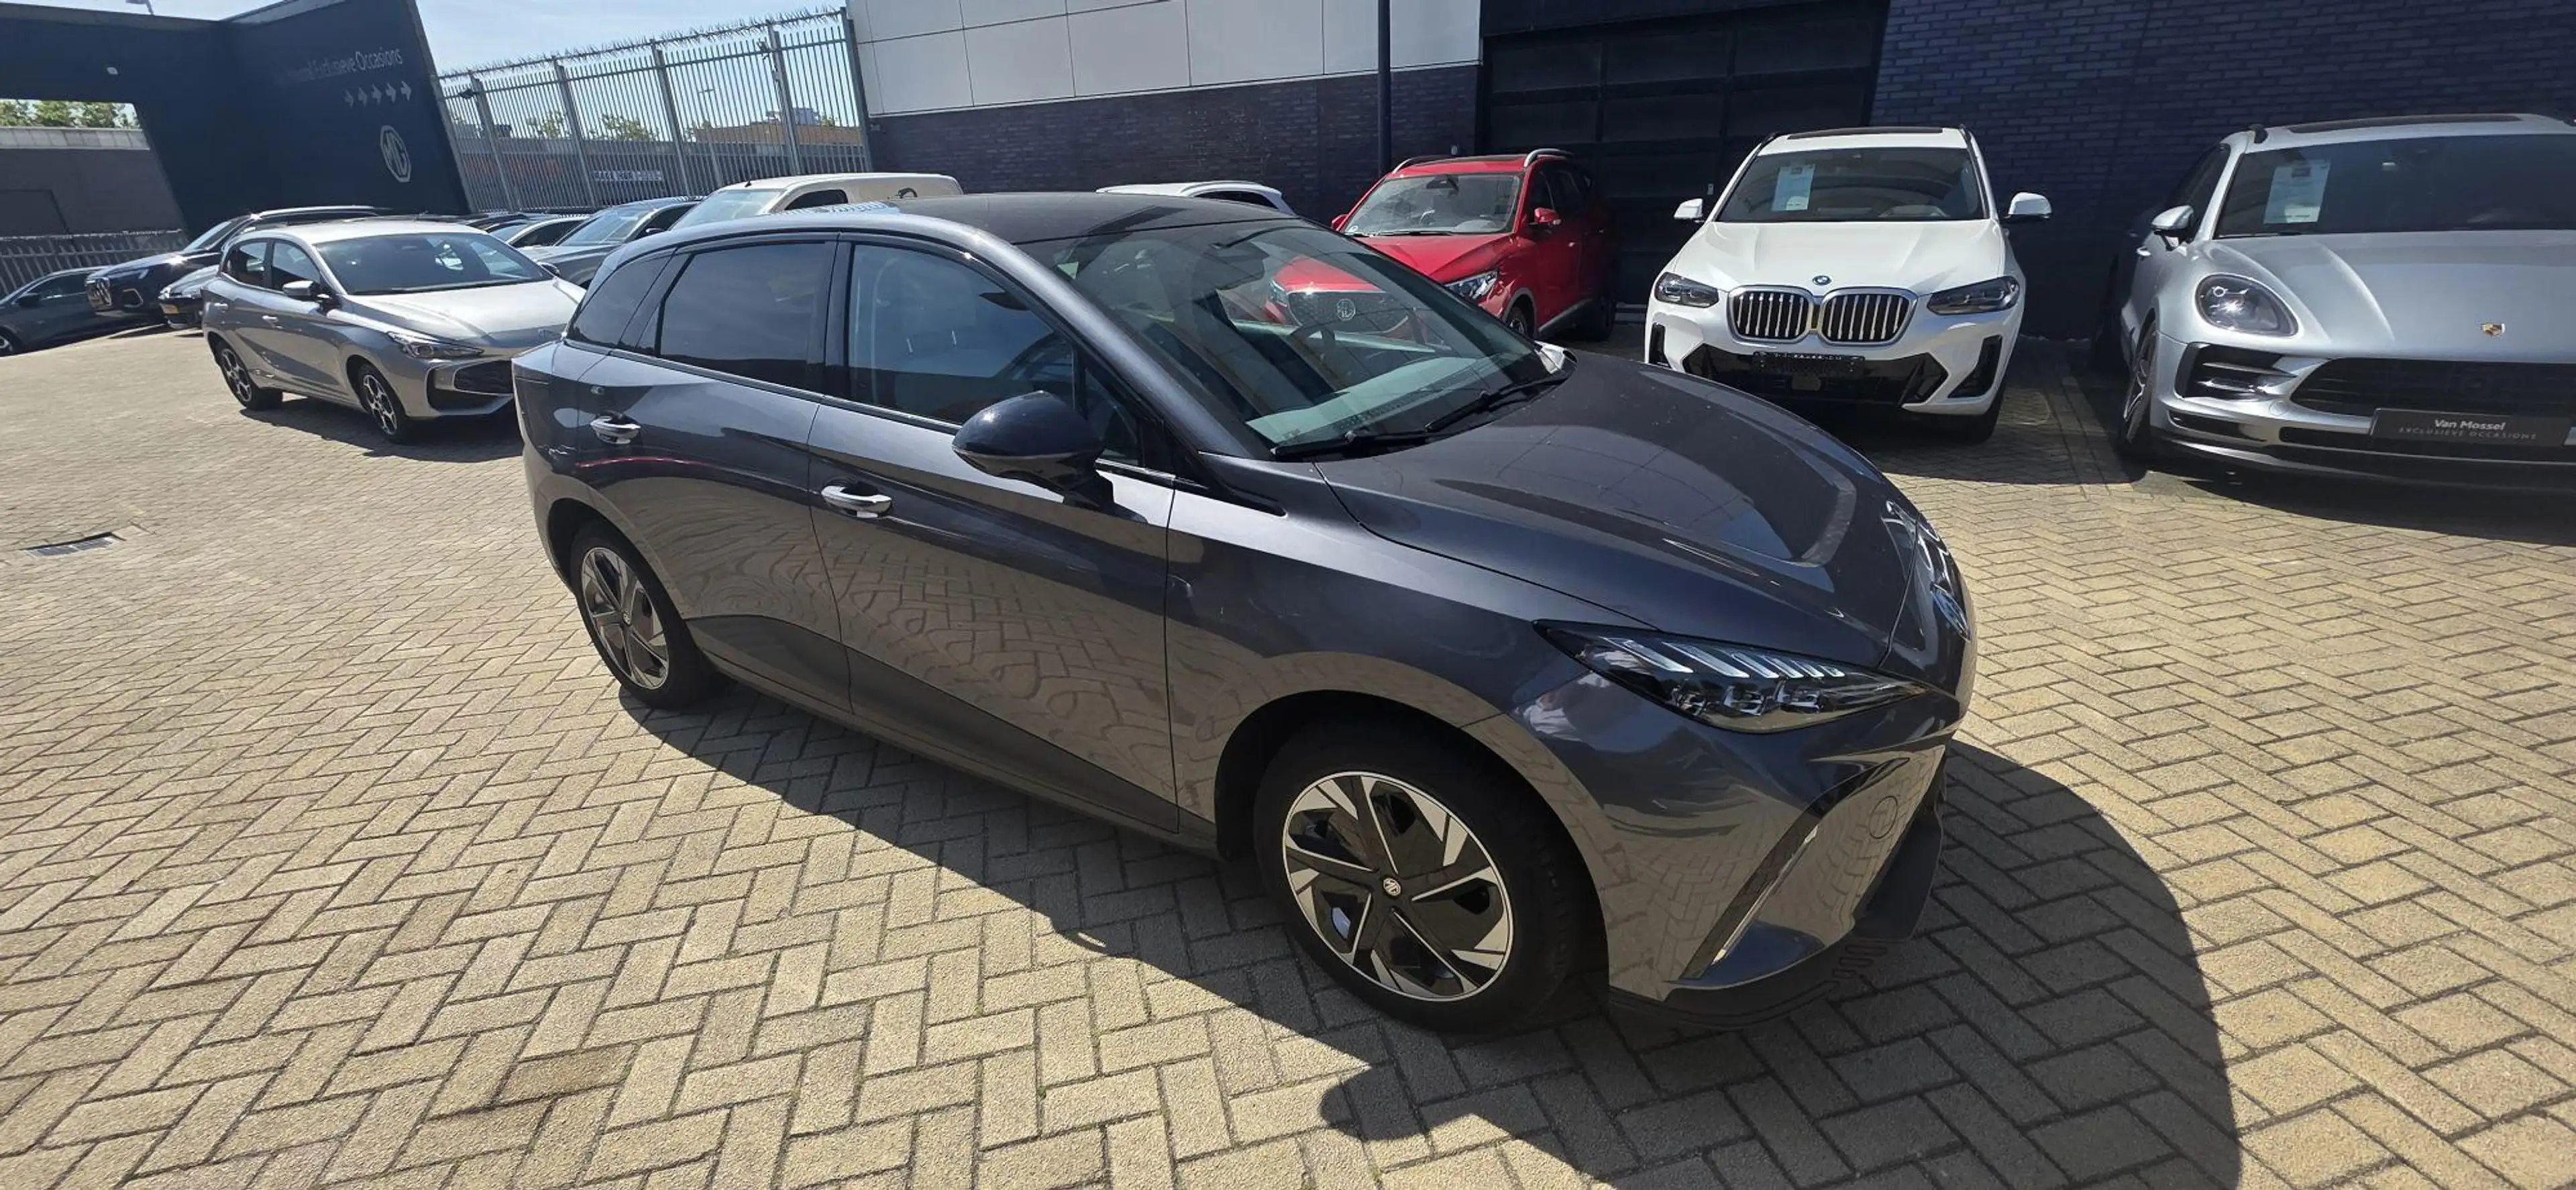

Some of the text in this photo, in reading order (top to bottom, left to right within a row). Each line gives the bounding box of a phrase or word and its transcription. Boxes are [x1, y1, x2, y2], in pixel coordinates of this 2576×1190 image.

[382, 129, 409, 178] MG
[2434, 419, 2506, 431] Van Mossel
[2398, 426, 2537, 441] EXCLUSIEVE OCCASIONS
